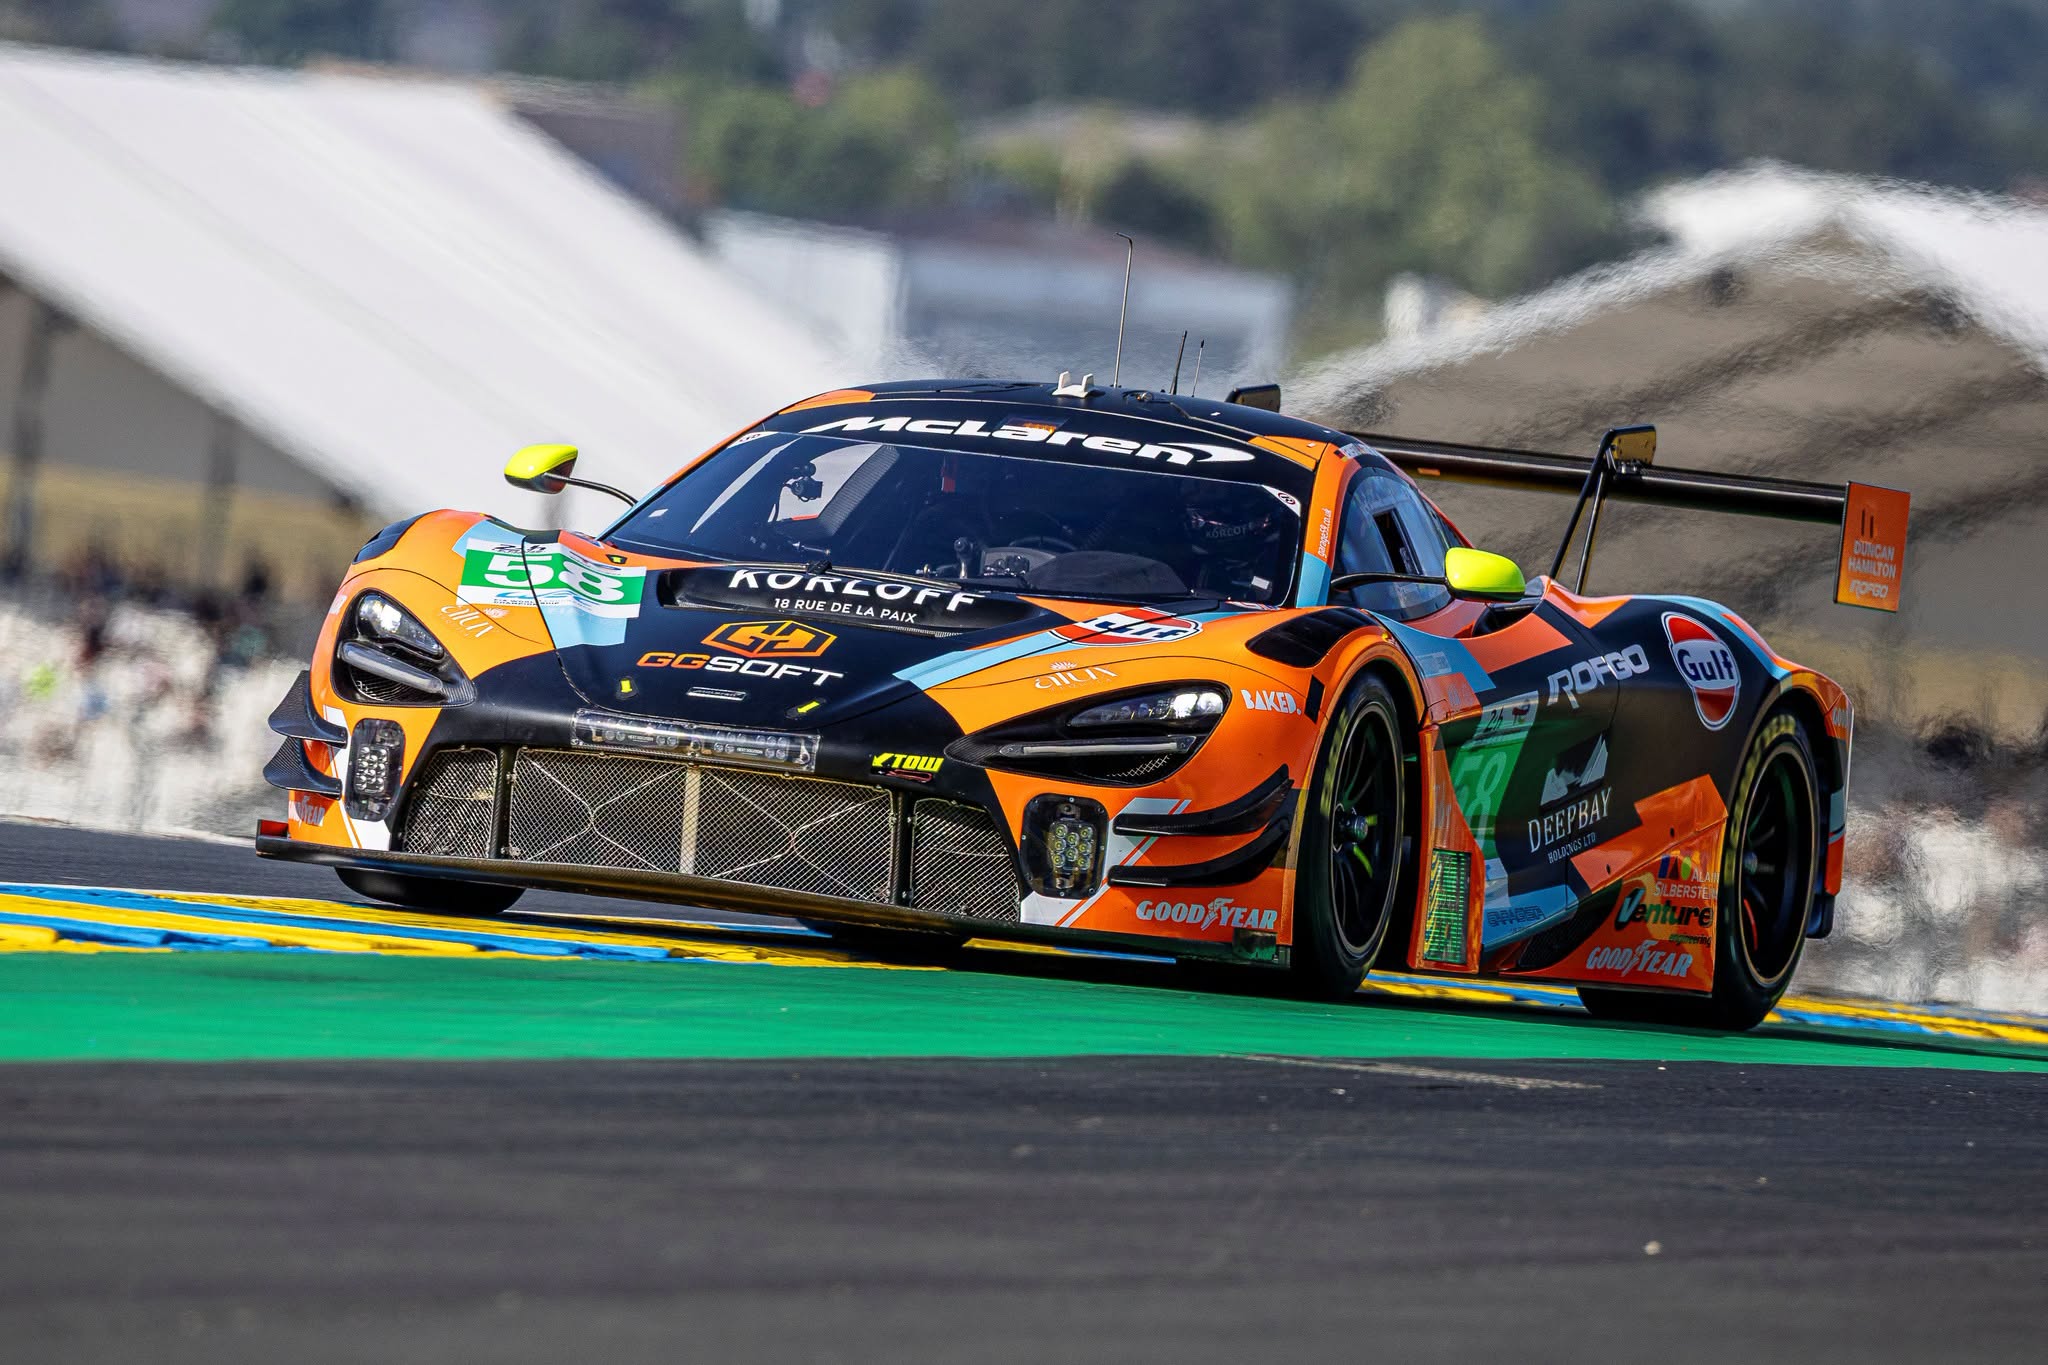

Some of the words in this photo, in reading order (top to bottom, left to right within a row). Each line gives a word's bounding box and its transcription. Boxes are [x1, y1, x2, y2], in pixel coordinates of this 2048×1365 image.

[798, 415, 1196, 466] McLaren
[1853, 539, 1895, 561] DUNCAN
[483, 554, 625, 602] 58
[1848, 557, 1897, 580] HAMILTON
[728, 568, 985, 612] KORLOFF
[774, 597, 790, 609] 18
[794, 599, 827, 611] RUE
[830, 602, 853, 614] DE
[855, 604, 875, 617] LA
[879, 608, 918, 624] PAIX
[636, 652, 845, 687] GGSOFT
[1546, 643, 1650, 710] ROFGO
[1677, 648, 1735, 682] Gulf
[891, 753, 945, 773] TOW
[1527, 785, 1612, 854] DEEPBAY
[1547, 838, 1582, 864] HOLDINGS
[1583, 831, 1597, 847] LTD
[1136, 897, 1279, 932] GOODYEAR
[1614, 888, 1714, 931] Venture
[1668, 932, 1712, 948] engineering
[1585, 939, 1694, 978] GOODYEAR
